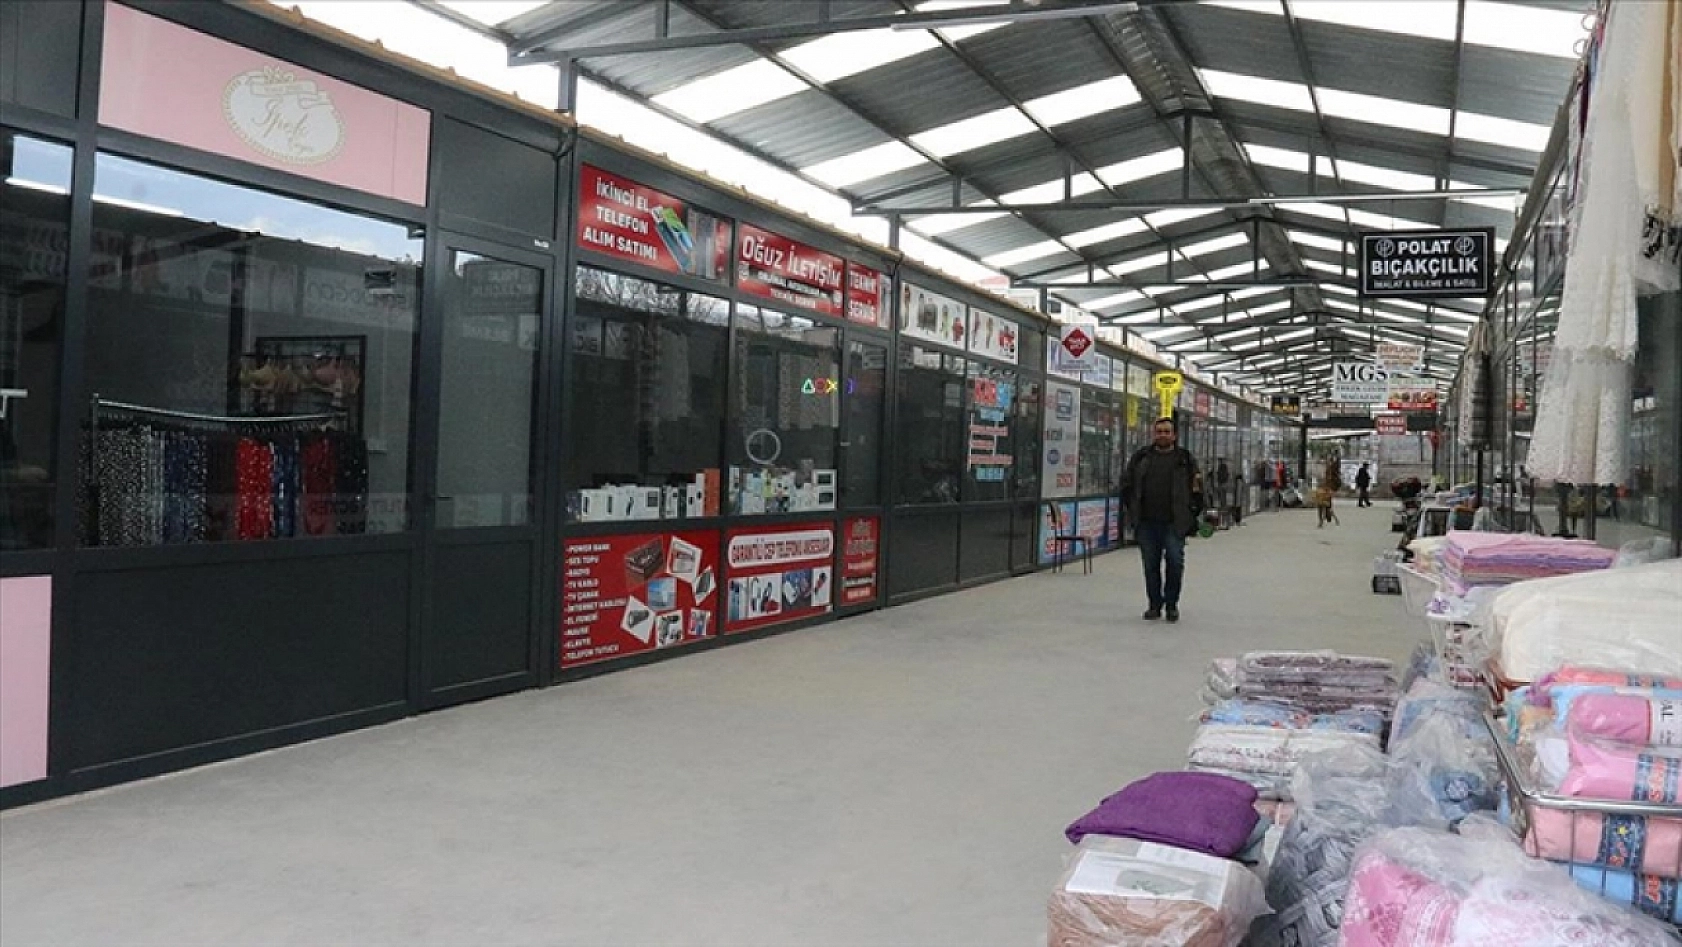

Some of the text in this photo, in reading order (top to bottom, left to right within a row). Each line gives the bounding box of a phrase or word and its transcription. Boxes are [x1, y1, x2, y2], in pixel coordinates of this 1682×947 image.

[596, 176, 649, 212] İKİNCİ EL
[596, 205, 649, 235] TELEFON
[583, 226, 658, 260] ALIM SATIMI
[1397, 239, 1451, 255] POLAT
[742, 235, 842, 288] OĞUZ İLETİŞİM
[1371, 257, 1479, 278] BIÇAKÇILIK
[1336, 363, 1388, 382] MGS
